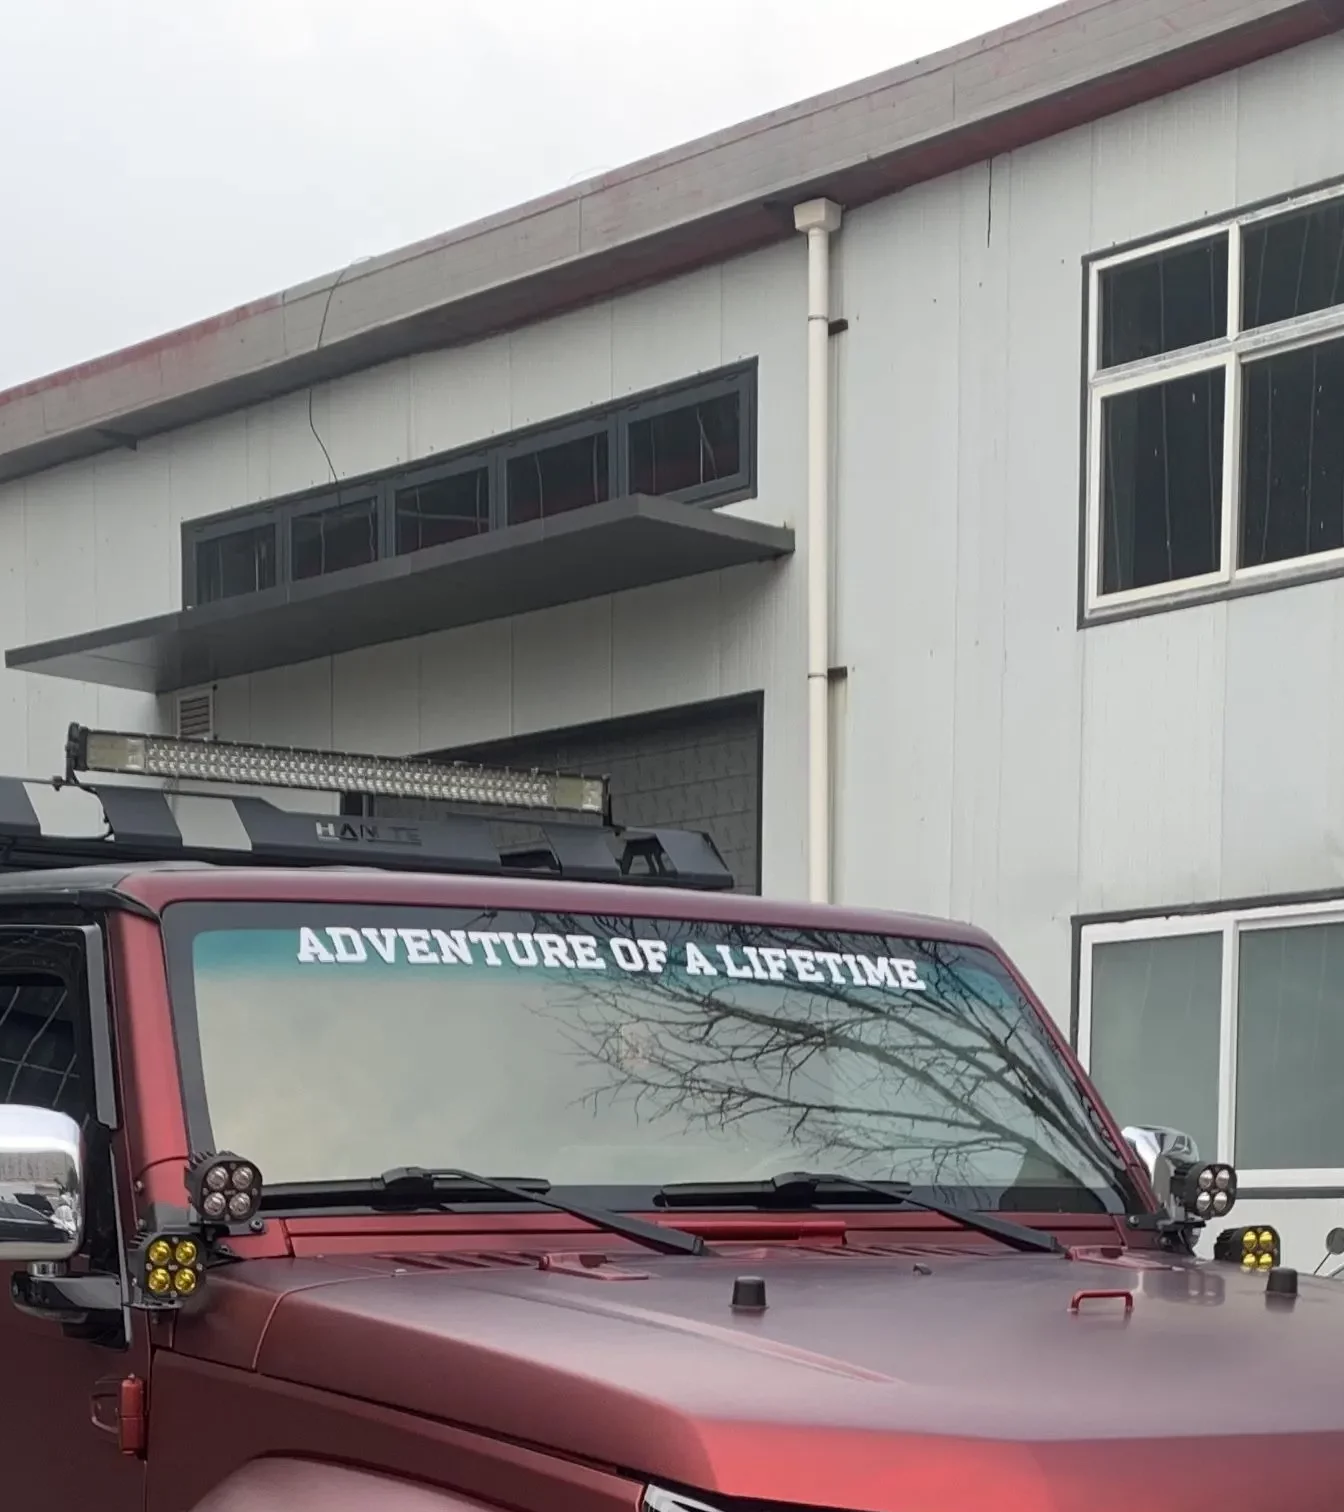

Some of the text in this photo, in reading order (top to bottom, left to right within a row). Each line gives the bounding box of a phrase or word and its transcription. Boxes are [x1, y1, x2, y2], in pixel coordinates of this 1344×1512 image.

[297, 926, 927, 991] ADVENTURE OF A LIFETIME
